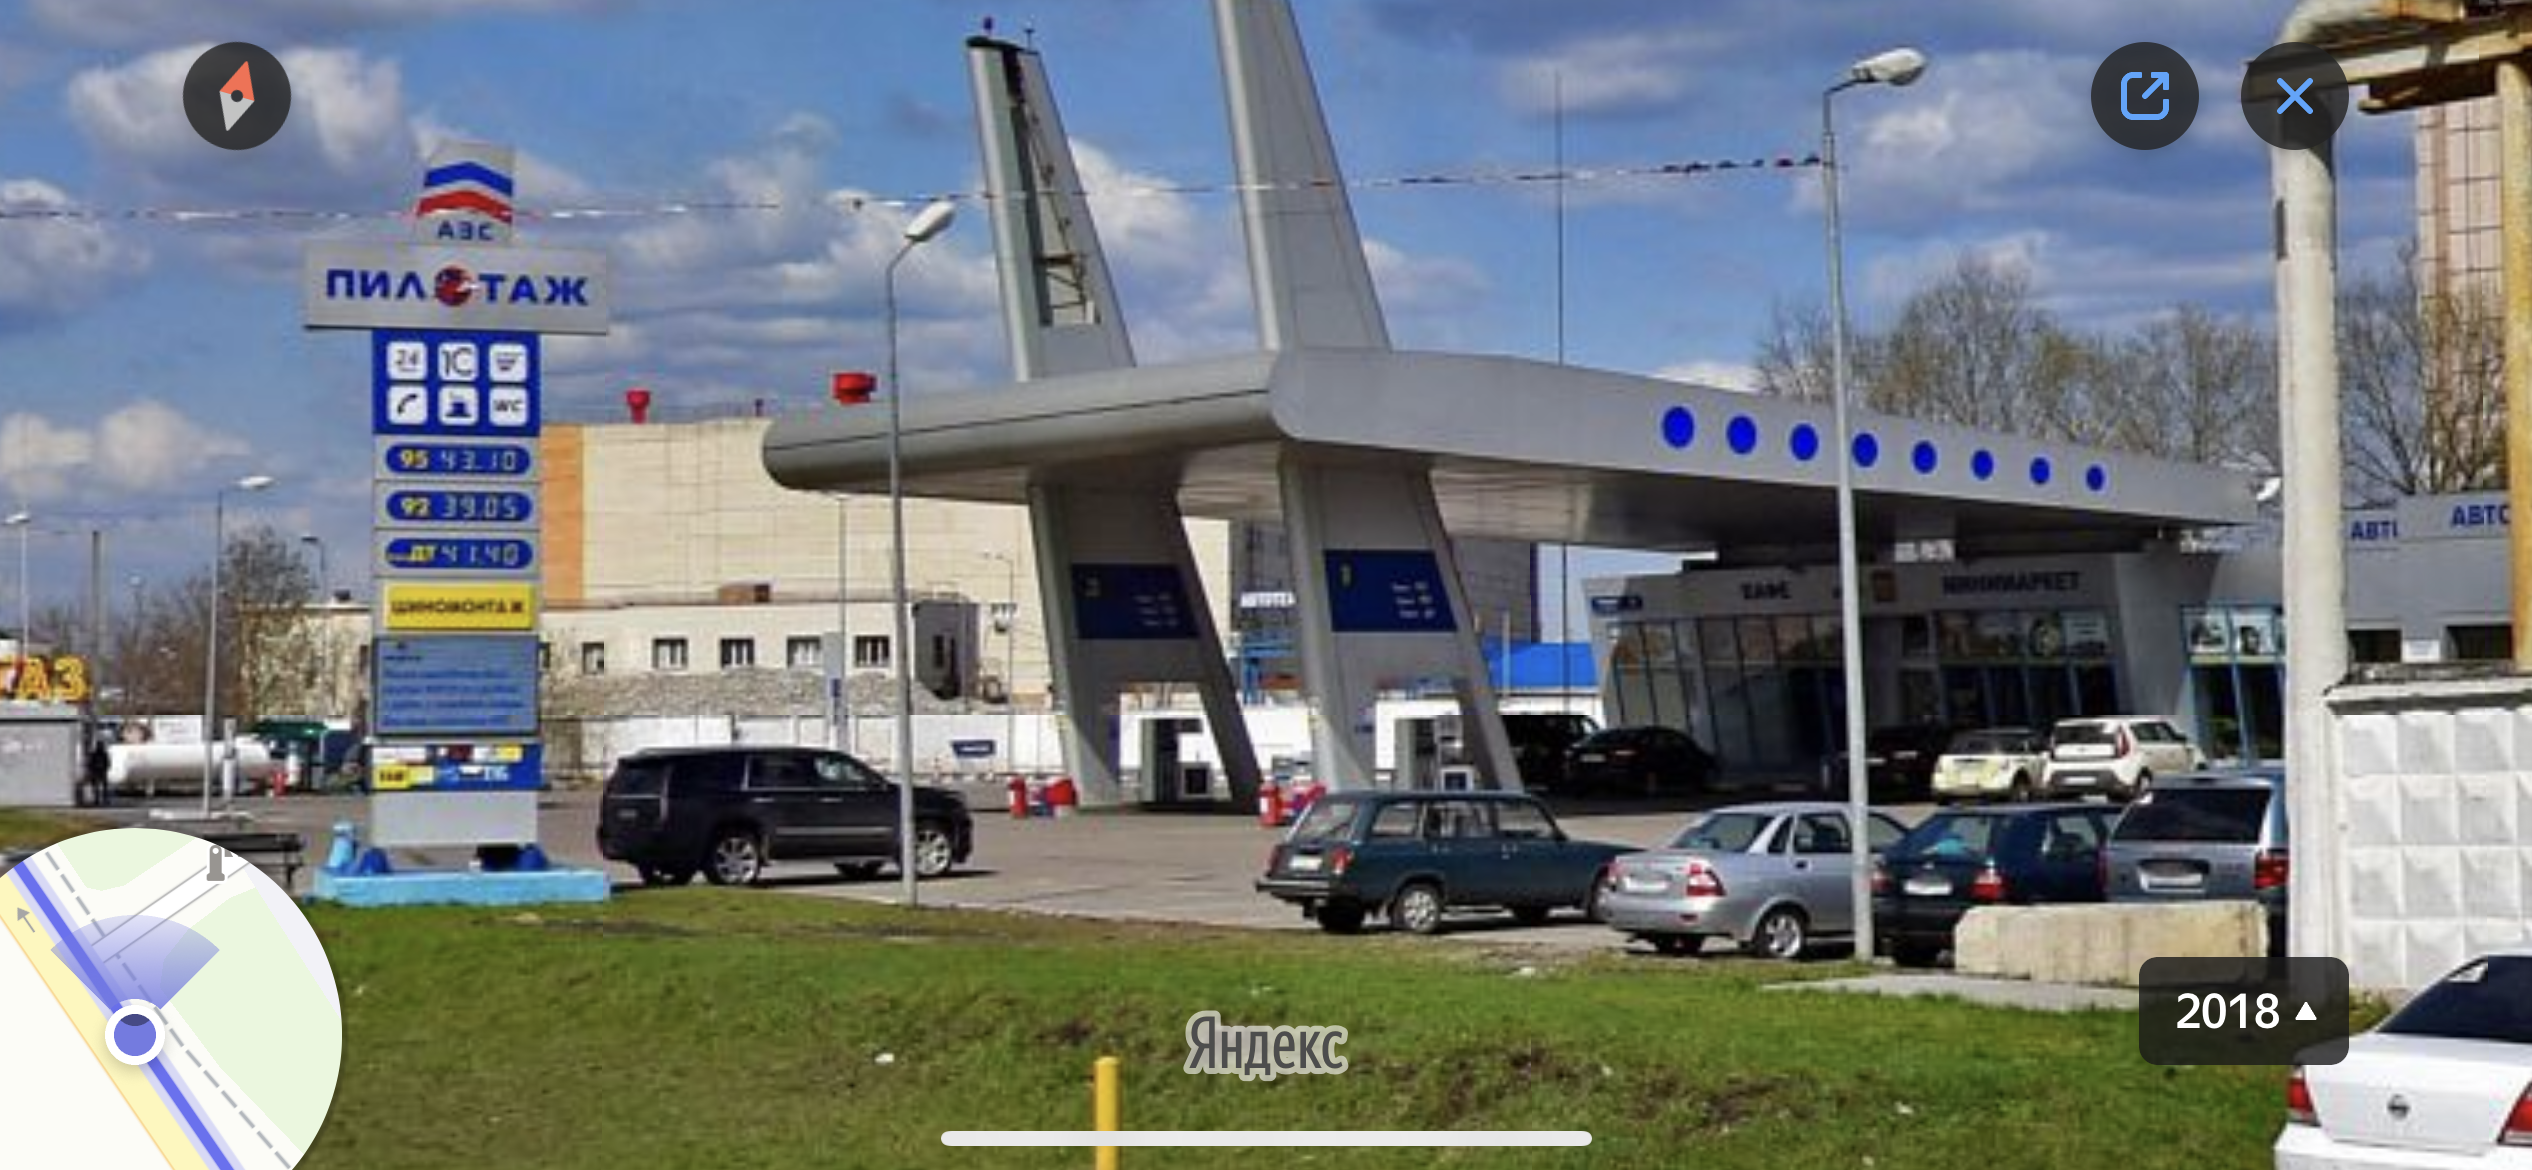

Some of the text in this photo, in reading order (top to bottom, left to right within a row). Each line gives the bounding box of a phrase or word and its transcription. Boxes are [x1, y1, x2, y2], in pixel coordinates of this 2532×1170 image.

[437, 220, 494, 241] АЗС
[401, 449, 429, 470] 95
[402, 497, 430, 517] 92
[2351, 520, 2398, 540] АВТ
